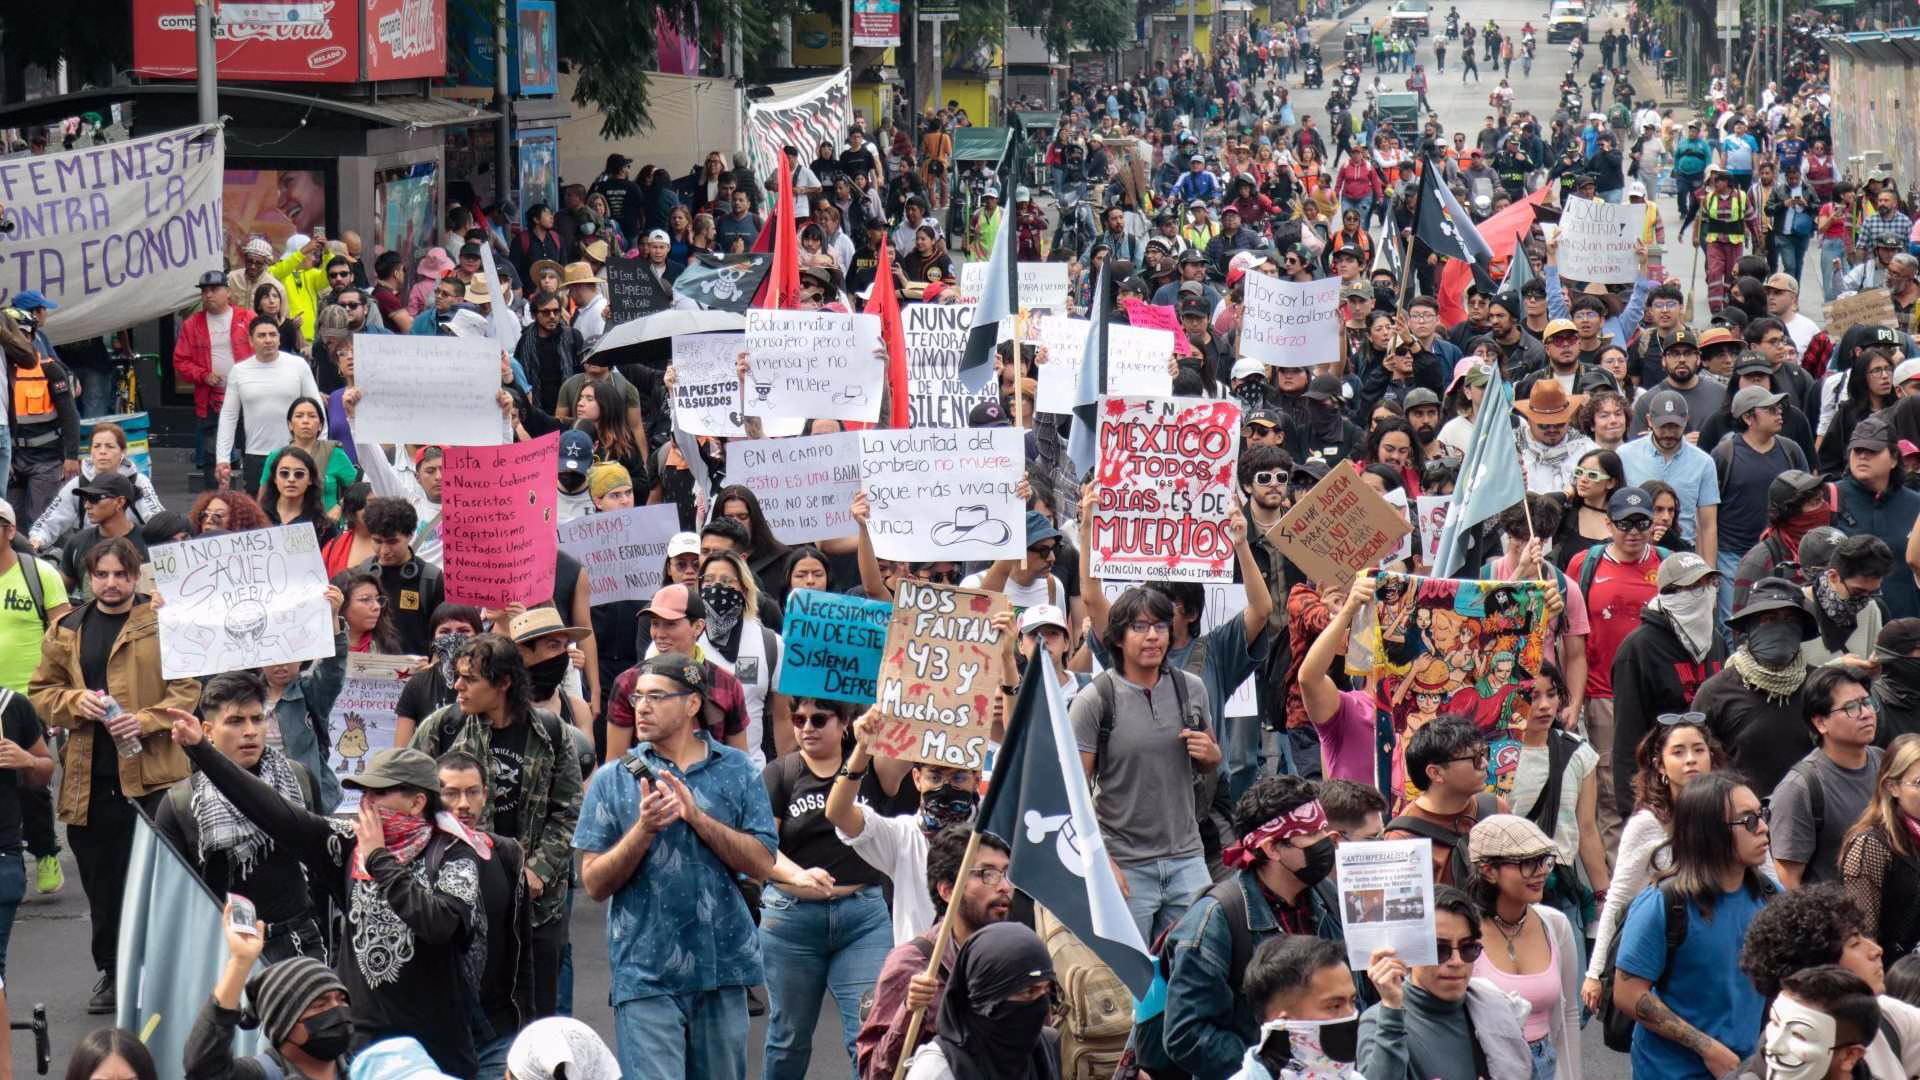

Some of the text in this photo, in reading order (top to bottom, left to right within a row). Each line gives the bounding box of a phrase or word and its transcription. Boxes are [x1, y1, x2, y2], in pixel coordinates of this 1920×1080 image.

[144, 174, 187, 218] LA
[1302, 289, 1314, 307] la
[799, 316, 834, 332] matar
[841, 316, 854, 332] al
[1257, 303, 1271, 322] los
[1272, 311, 1296, 329] que
[745, 333, 856, 354] mensajero pero el
[756, 353, 848, 375] mensaje no
[673, 381, 739, 399] IMPUESTOS
[785, 377, 831, 394] muere
[918, 380, 933, 395] DE
[677, 395, 733, 410] ABSURDOS
[863, 429, 994, 453] La voluntad del
[1100, 416, 1232, 460] MÉXICO
[442, 447, 481, 471] Lista
[492, 448, 506, 468] de
[935, 458, 954, 472] no
[1129, 454, 1212, 482] TODOS
[453, 494, 513, 510] Fascistas
[786, 496, 802, 510] NO
[869, 484, 911, 510] Sigue
[917, 480, 951, 498] más
[960, 481, 994, 496] viva
[1098, 482, 1225, 515] DÍAS ES DE
[454, 511, 517, 525] Sionistas
[454, 526, 525, 541] Capitalismo
[1092, 513, 1235, 561] MUERTOS
[1329, 522, 1350, 541] NO
[455, 541, 502, 556] Estados
[1329, 540, 1356, 566] PAZ
[153, 556, 177, 574] 40
[456, 553, 536, 570] Neocolonialismo
[1093, 562, 1101, 573] A
[1146, 567, 1188, 578] GOBIERNO
[179, 551, 288, 610] SAQUEO
[456, 586, 496, 602] Estado
[897, 580, 957, 614] NOS
[788, 591, 893, 626] NECESITAMOS
[788, 618, 885, 650] FIN DE ESTE
[906, 639, 951, 682] 43
[880, 676, 972, 728] Muchos
[788, 793, 826, 818] BOSS
